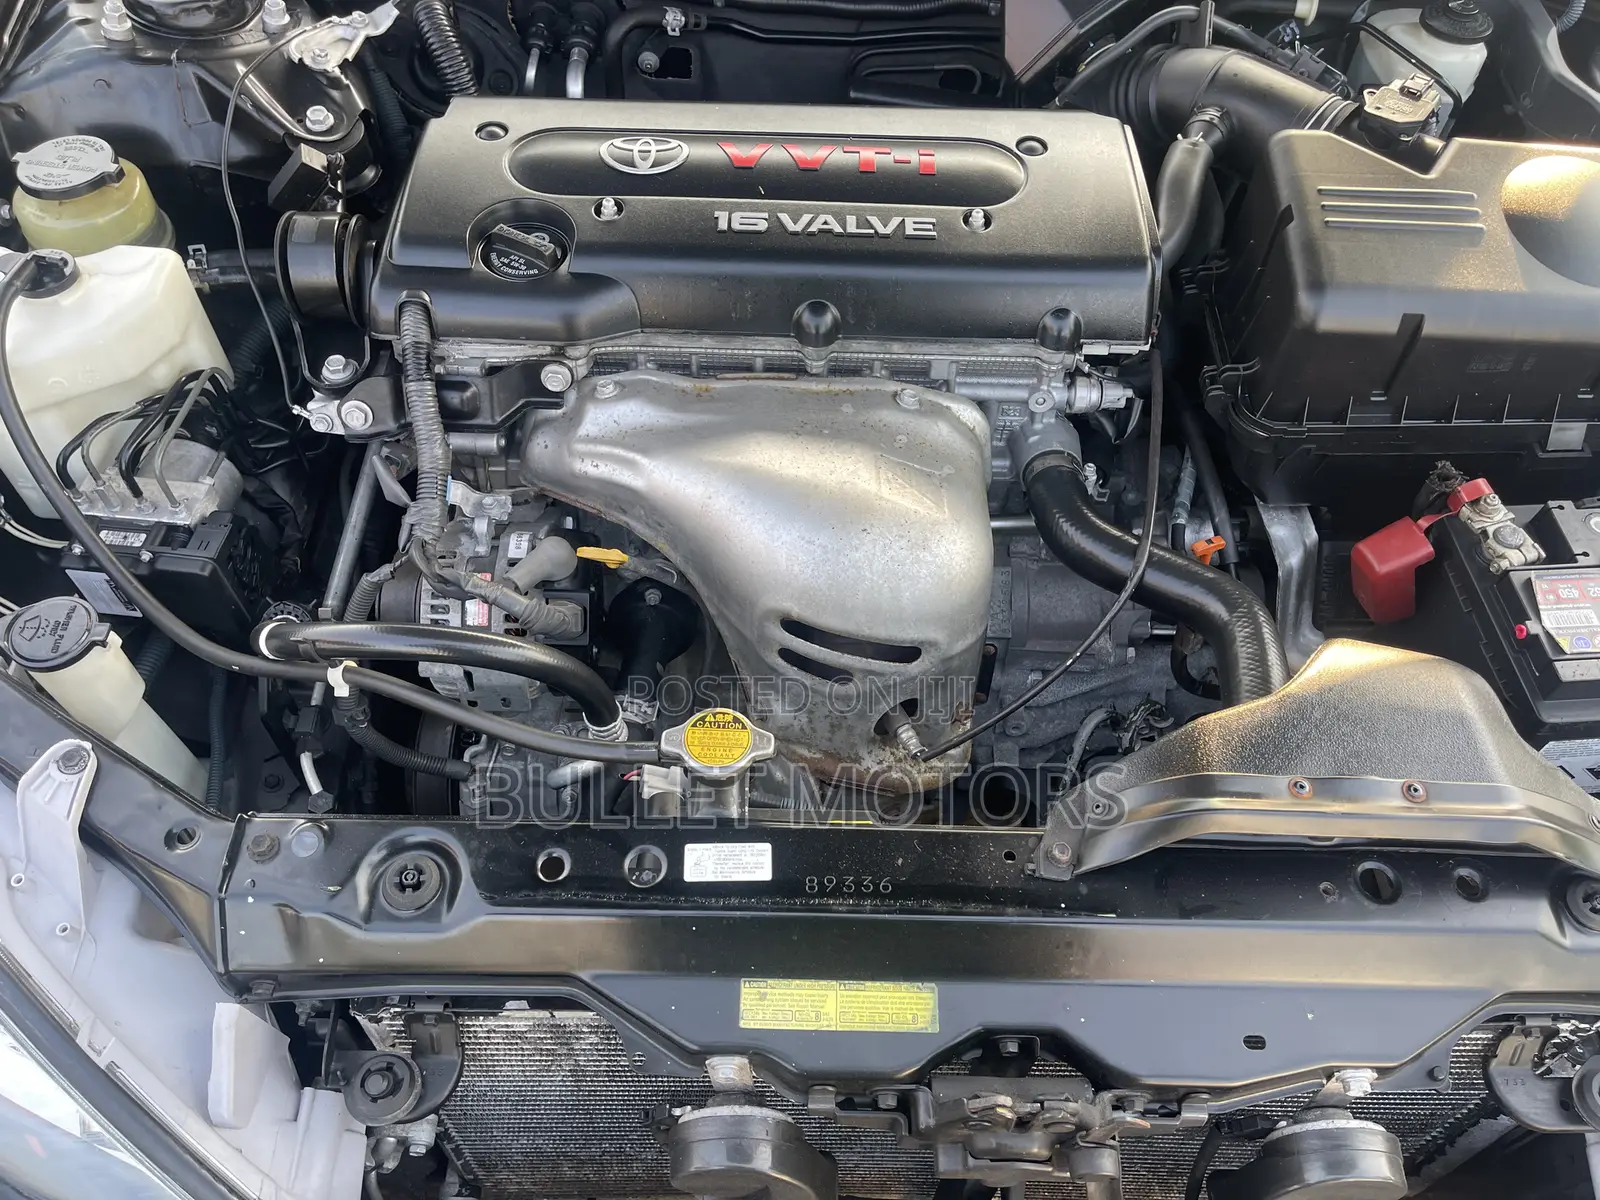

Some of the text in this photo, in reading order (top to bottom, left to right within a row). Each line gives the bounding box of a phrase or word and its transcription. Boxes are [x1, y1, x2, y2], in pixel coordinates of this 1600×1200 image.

[716, 141, 937, 176] VVT-i
[713, 210, 937, 241] 16 VALVE
[489, 252, 539, 275] ENERGY CONSERVING
[499, 256, 527, 271] SAE 5W-30
[1558, 588, 1580, 599] 450
[696, 721, 742, 729] CAUTION
[805, 876, 892, 893] 89336
[814, 1013, 819, 1021] 8
